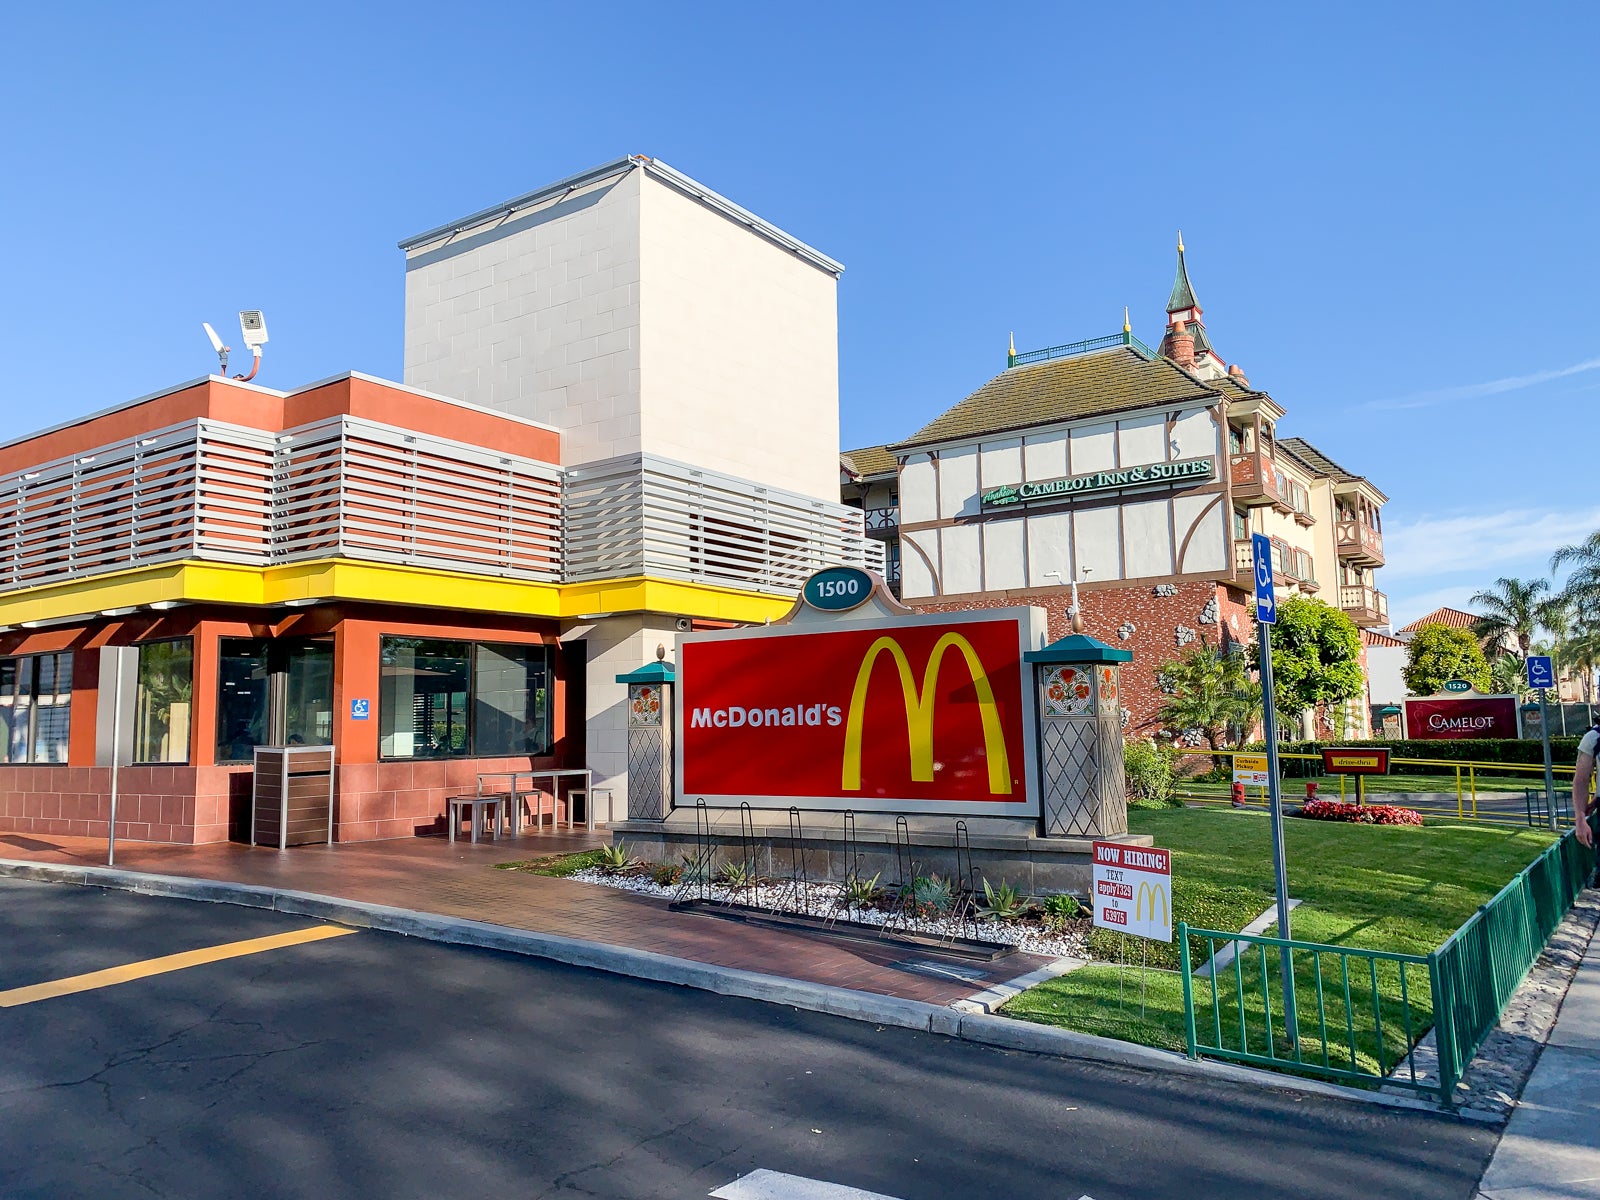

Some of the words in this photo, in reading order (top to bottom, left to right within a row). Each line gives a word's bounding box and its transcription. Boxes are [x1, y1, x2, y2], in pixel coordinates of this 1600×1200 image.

[1019, 475, 1095, 497] CAMELOT
[1096, 470, 1129, 488] INN
[1130, 467, 1148, 482] &
[1150, 459, 1211, 479] SUITES
[816, 579, 859, 598] 1500
[690, 703, 842, 728] McDonald's
[1428, 713, 1495, 729] CAMELOT
[1097, 846, 1119, 863] NOW
[1124, 849, 1167, 870] HIRING!
[1106, 869, 1123, 881] TEXT
[1099, 883, 1132, 897] apply7329
[1111, 899, 1118, 908] to
[1105, 909, 1125, 923] 63975
